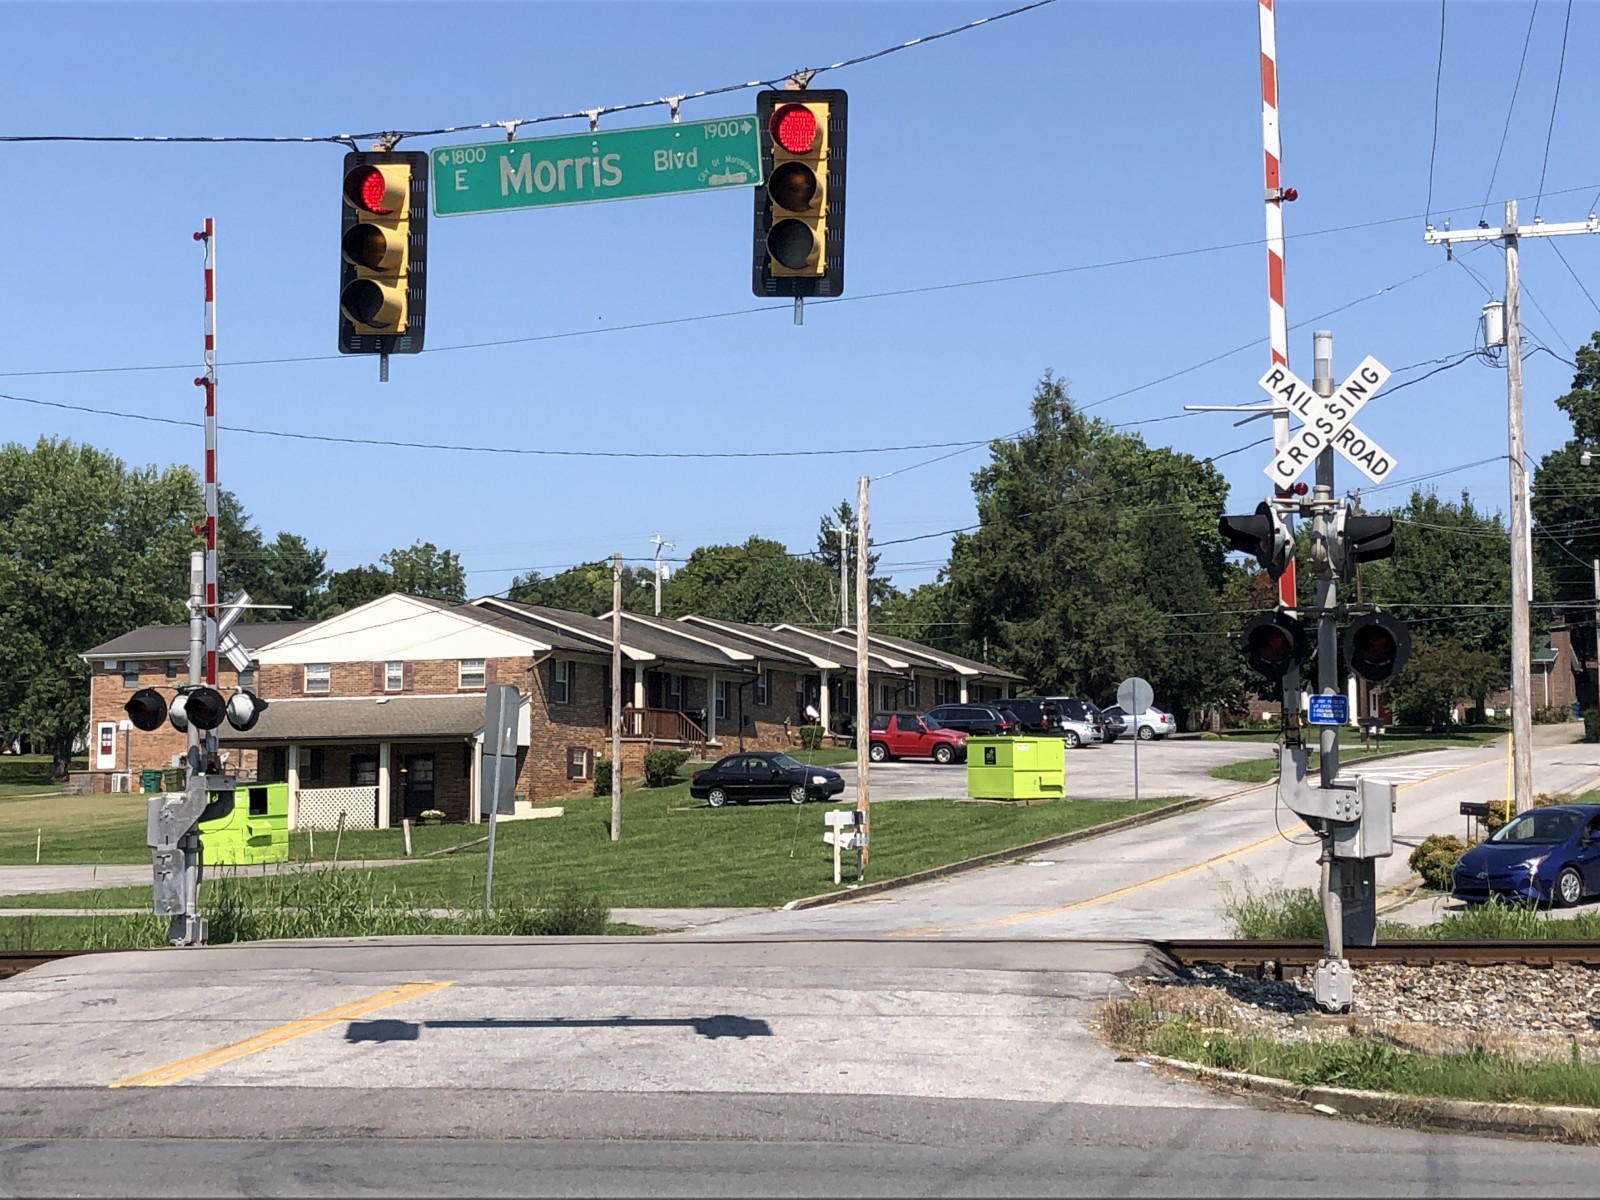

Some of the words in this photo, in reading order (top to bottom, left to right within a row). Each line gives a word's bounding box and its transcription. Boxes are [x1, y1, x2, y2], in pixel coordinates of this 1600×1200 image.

[703, 121, 739, 140] 1900
[451, 147, 487, 165] 1800
[455, 169, 470, 191] E
[500, 146, 623, 196] Morris
[653, 146, 698, 172] Blvd
[1265, 368, 1312, 417] RAIL
[1336, 428, 1389, 476] ROAD
[1276, 367, 1379, 477] CROSSING
